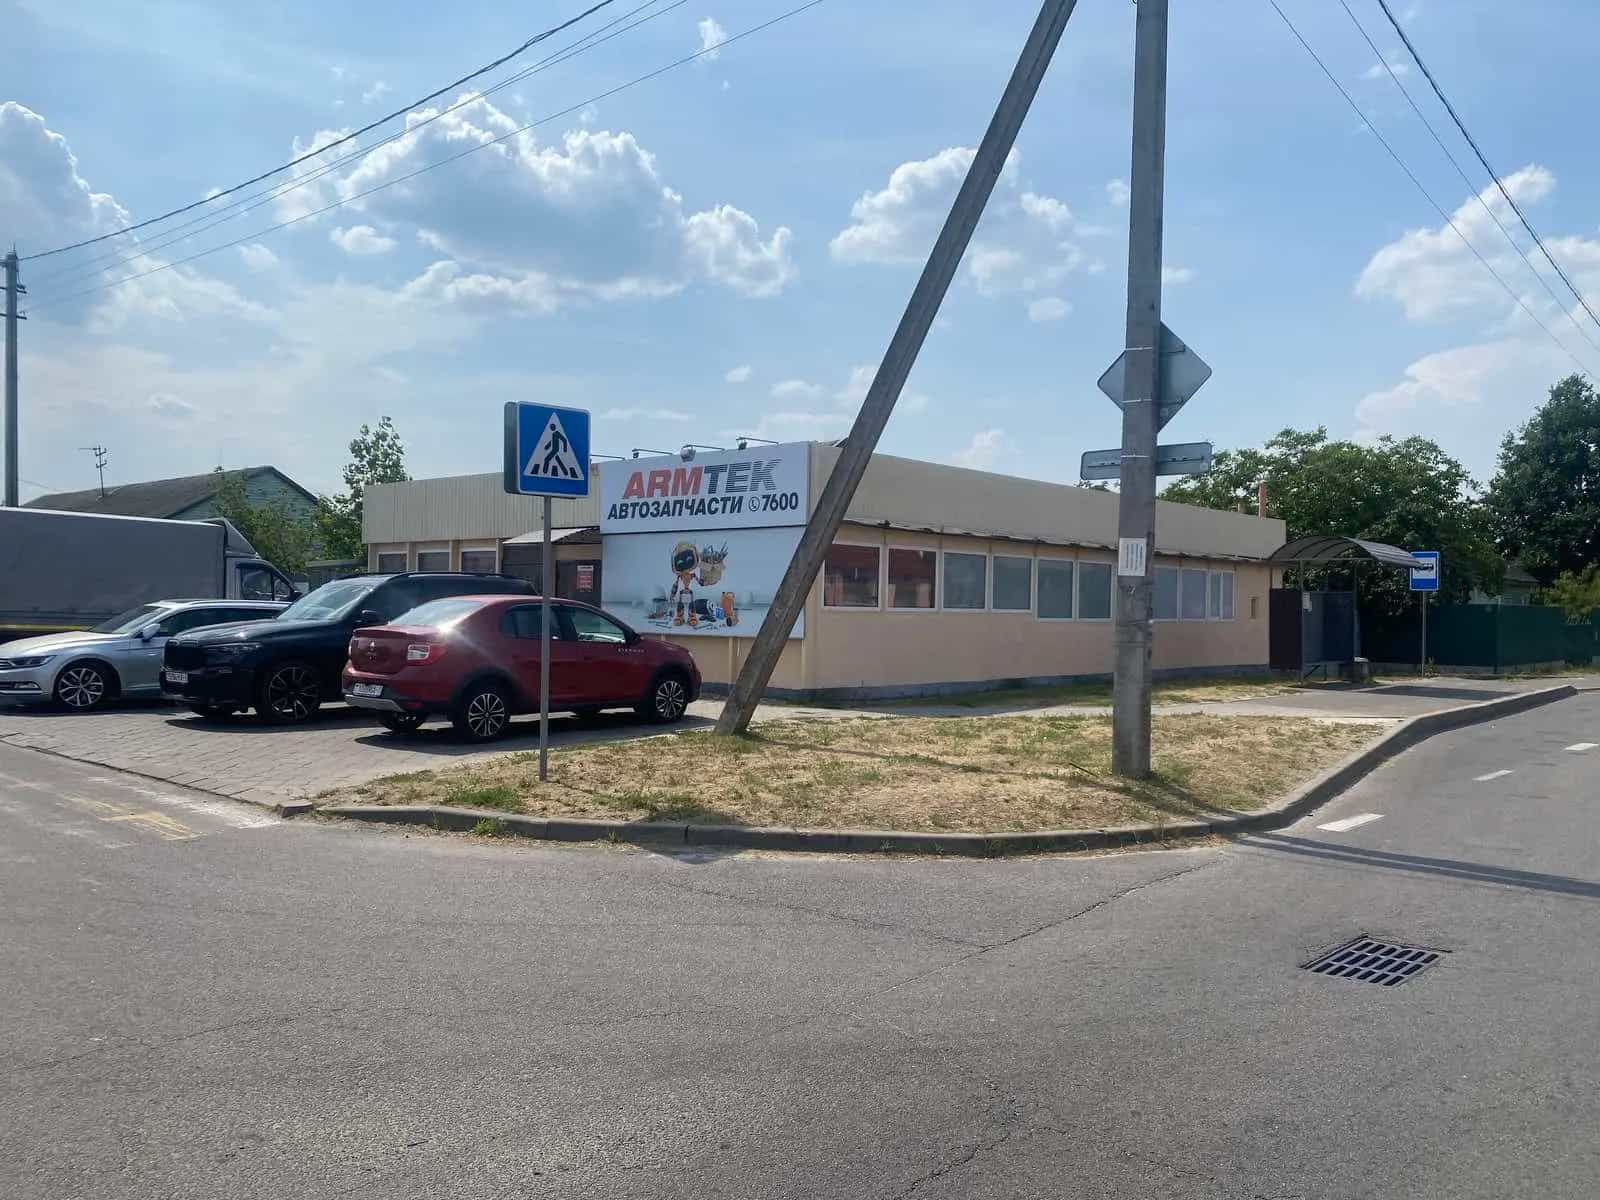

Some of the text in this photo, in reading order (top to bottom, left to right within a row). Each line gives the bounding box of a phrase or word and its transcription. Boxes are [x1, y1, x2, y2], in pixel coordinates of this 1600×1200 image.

[622, 459, 782, 499] ARMTEK
[607, 492, 799, 520] АВТОЗАПЧАСТИ 7600
